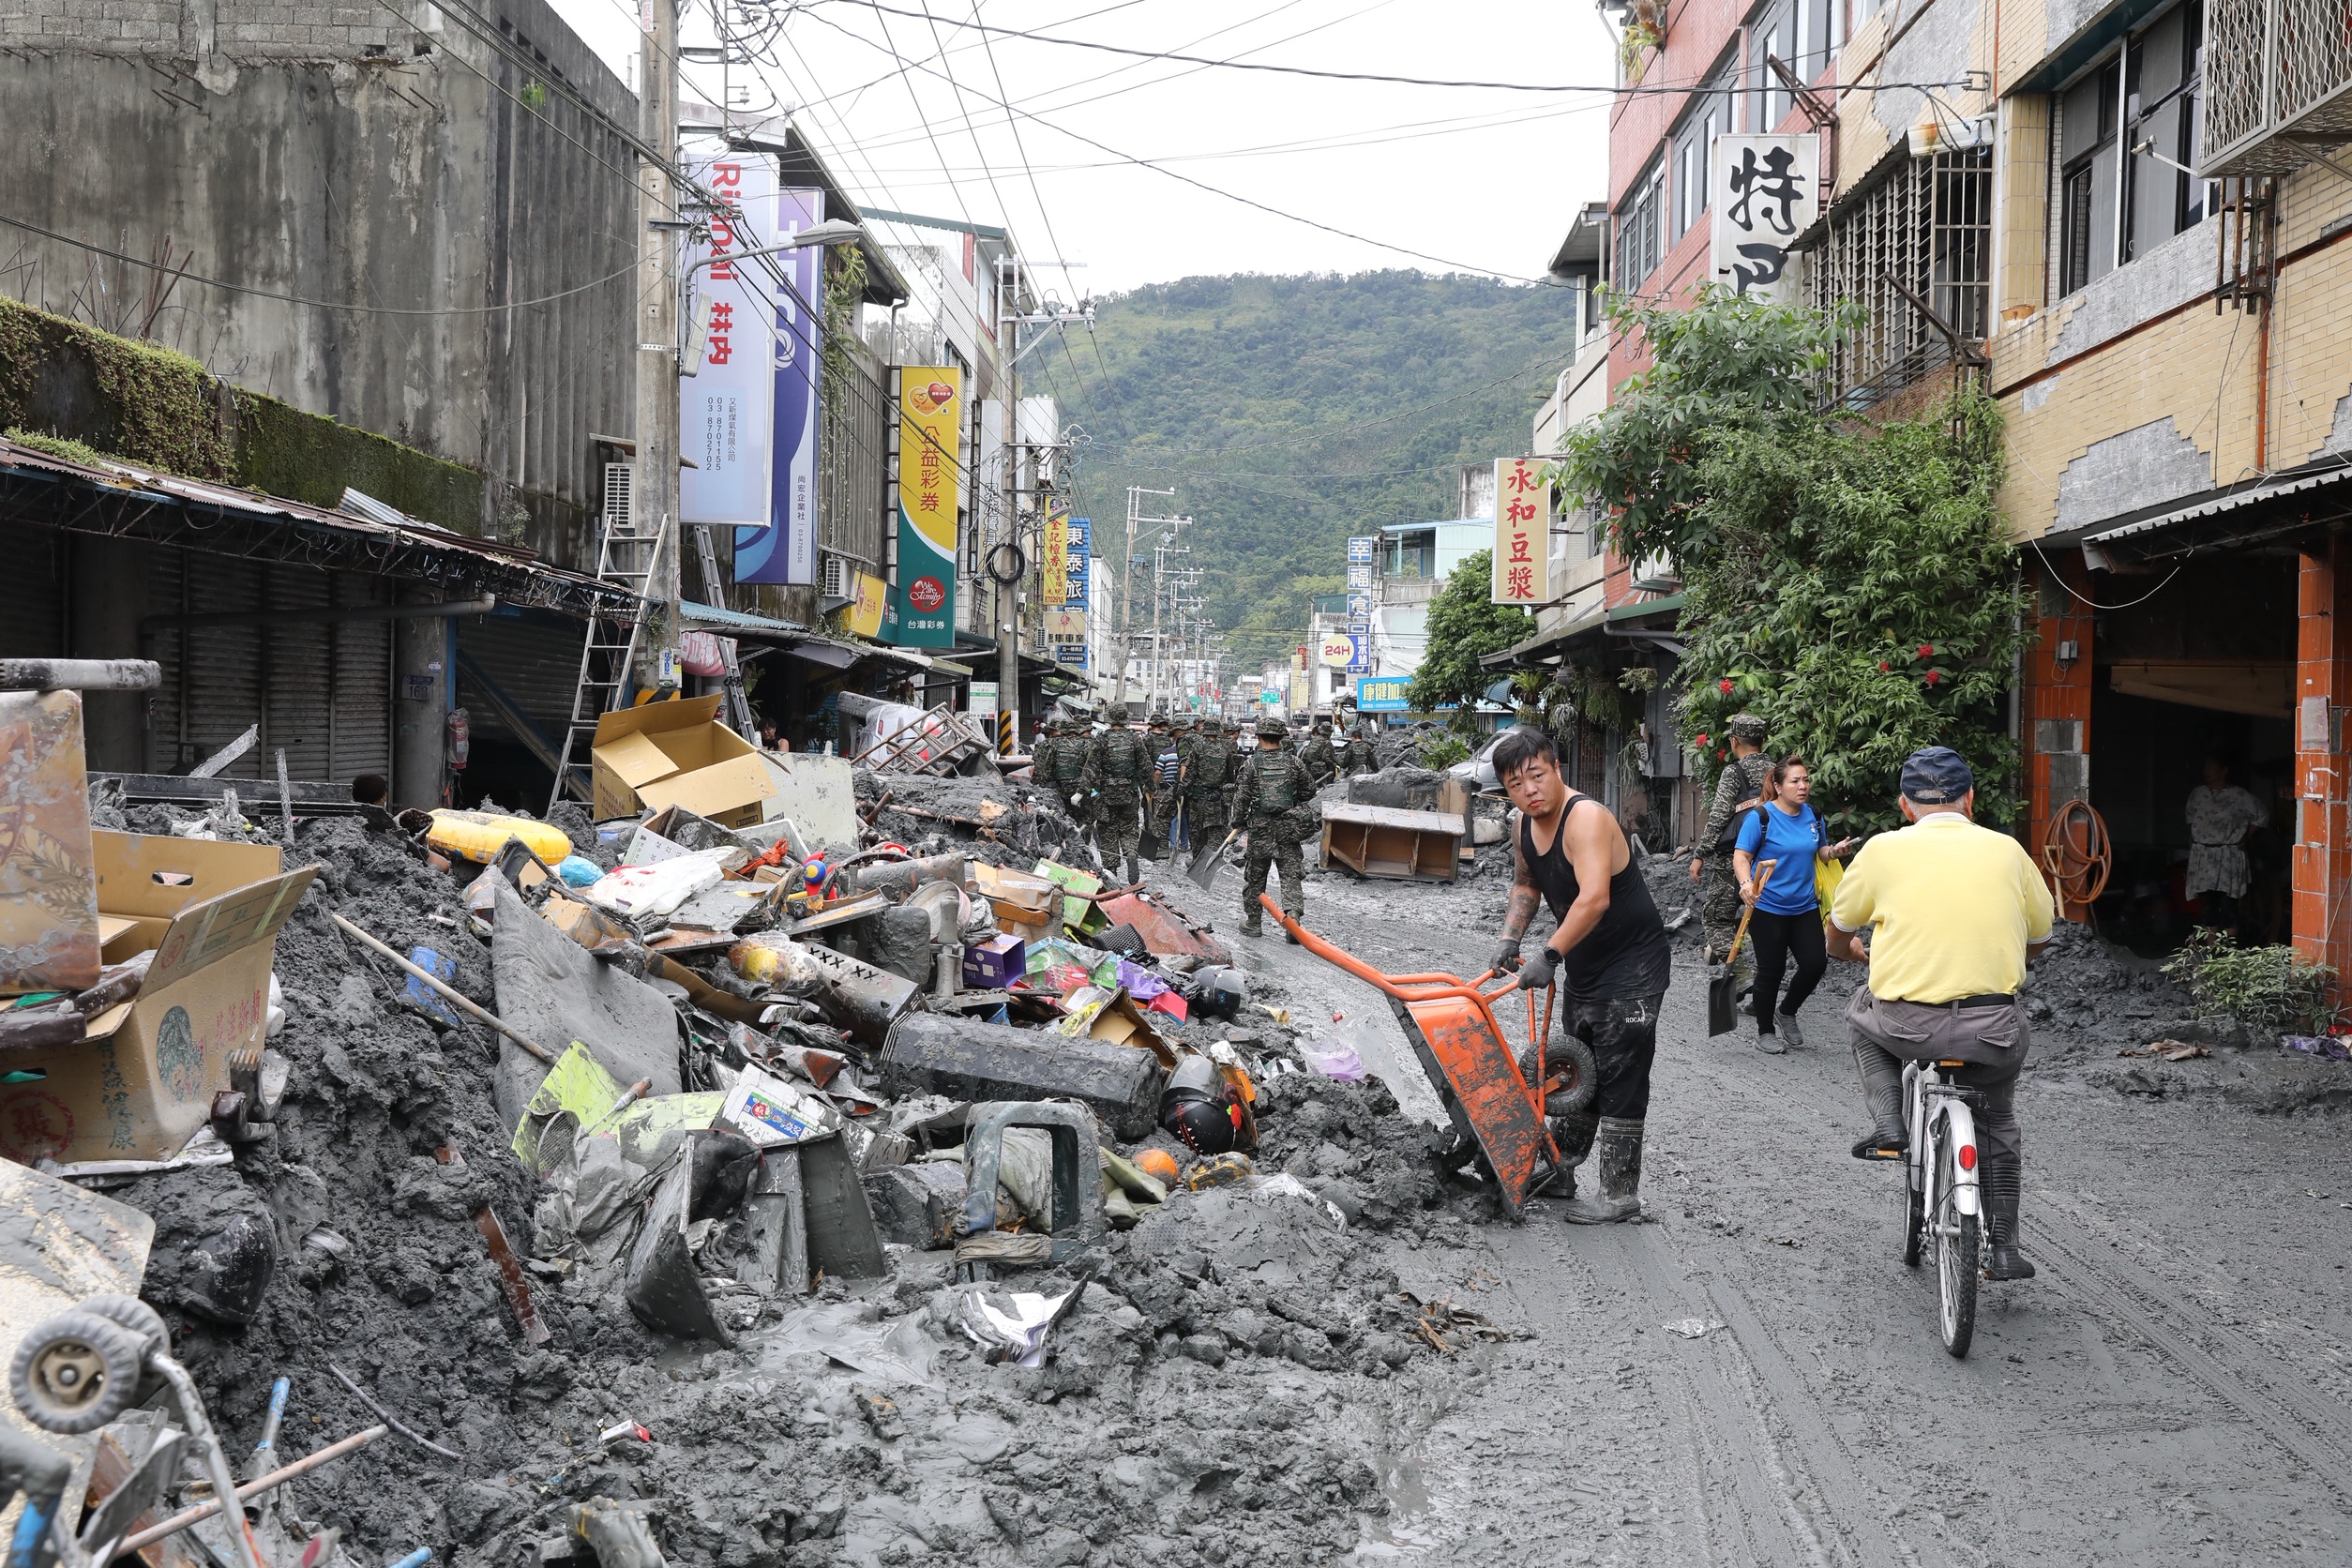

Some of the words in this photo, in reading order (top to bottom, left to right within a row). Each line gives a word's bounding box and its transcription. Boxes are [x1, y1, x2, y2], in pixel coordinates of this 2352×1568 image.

[728, 398, 736, 462] 又新煤氣有限公司
[920, 426, 941, 512] 公益彩券
[797, 475, 806, 520] 尚宏企業社
[1506, 460, 1538, 600] 永和豆漿
[1066, 527, 1084, 611] 東泰旅
[908, 620, 945, 629] 台灣彩券
[1325, 645, 1350, 656] 24H
[1357, 636, 1368, 665] 加水站
[1363, 683, 1408, 701] 康健加
